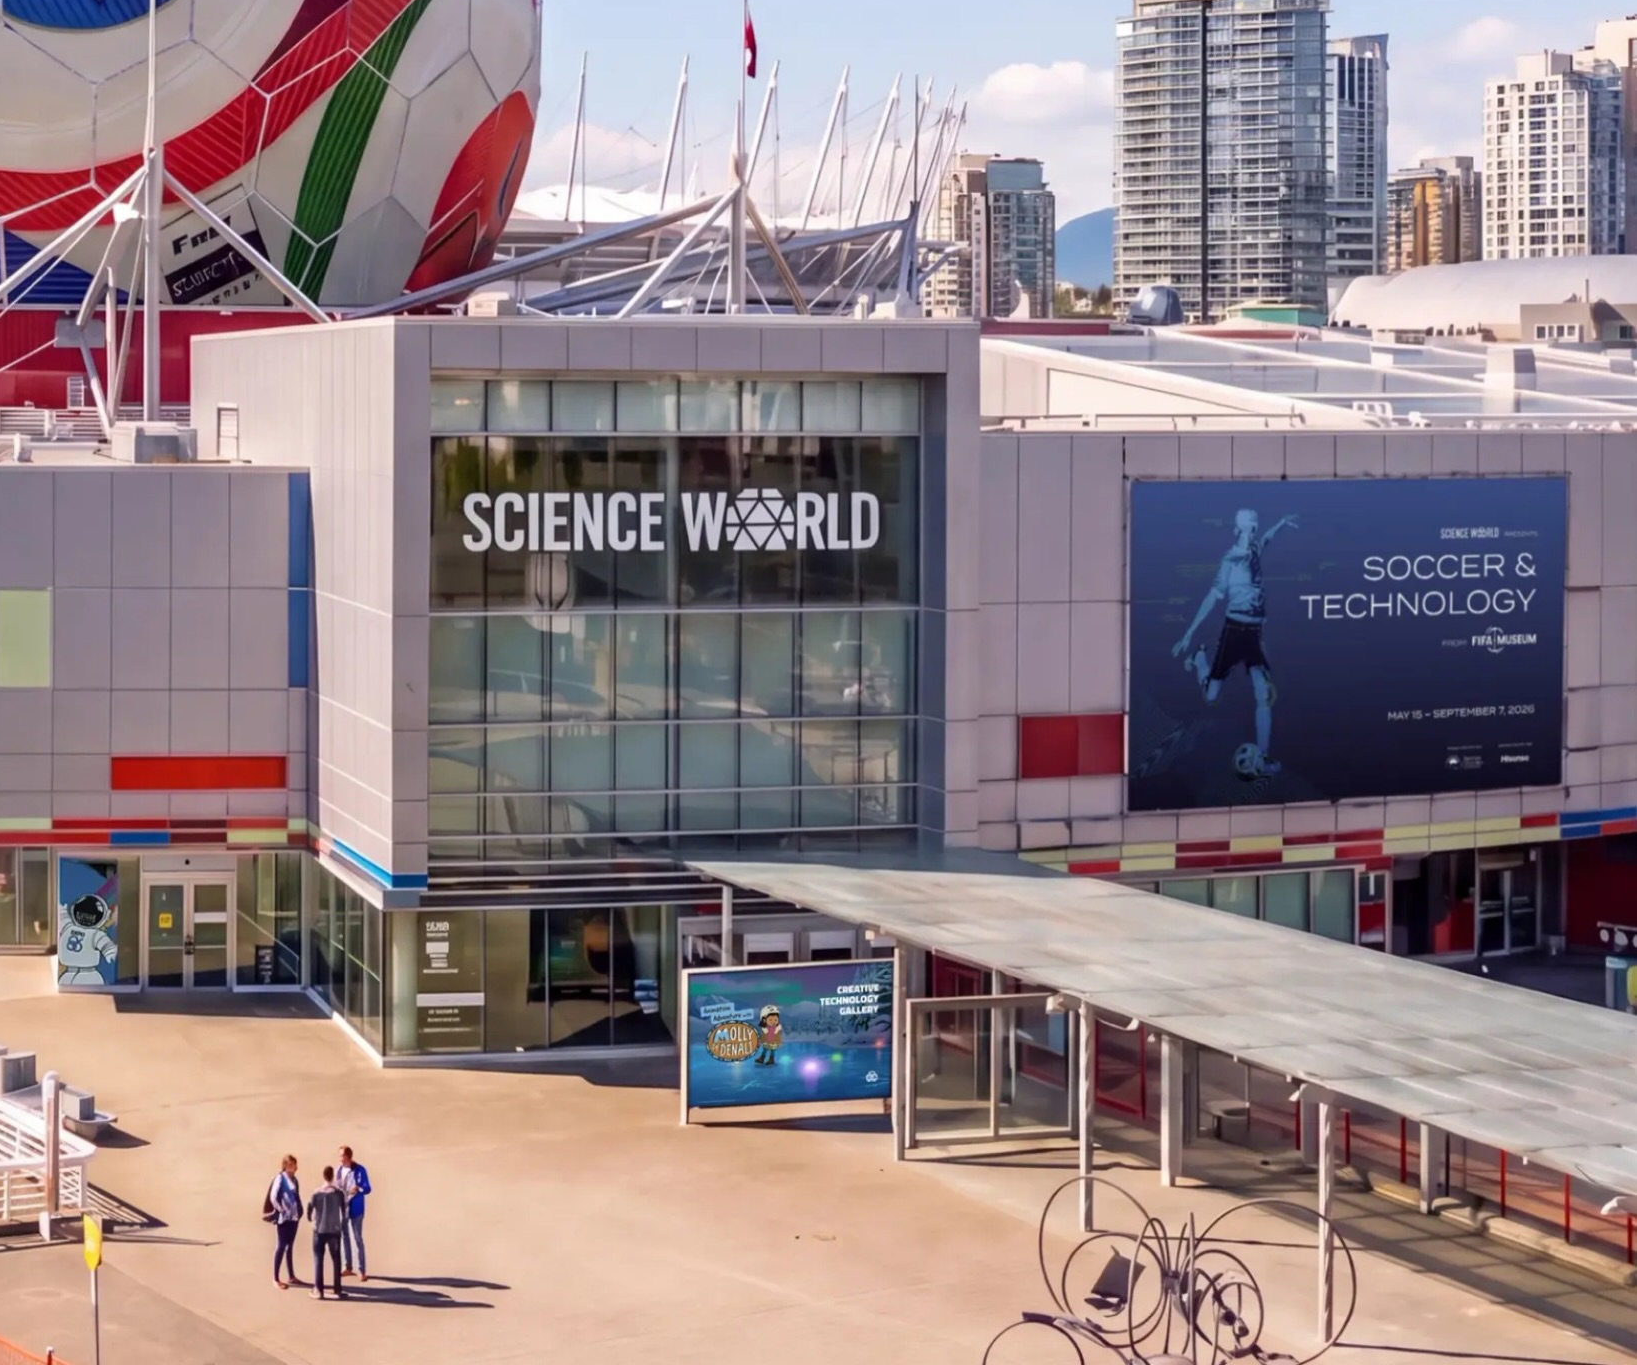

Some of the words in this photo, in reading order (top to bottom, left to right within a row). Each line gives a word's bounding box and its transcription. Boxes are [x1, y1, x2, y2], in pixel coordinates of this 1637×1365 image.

[462, 491, 665, 552] SCIENCE
[681, 488, 880, 552] WORLD
[1440, 527, 1469, 540] SCIENCE
[1363, 553, 1505, 581] SOCCER
[1515, 552, 1538, 577] &
[1299, 588, 1537, 620] TECHNOLOGY
[1471, 635, 1493, 647] FIFA
[1496, 633, 1537, 645] MUSEUM
[1387, 710, 1411, 721] MAY
[1412, 710, 1423, 720] 15
[1433, 706, 1496, 719] SEPTEMBER
[1507, 704, 1536, 715] 2026
[836, 983, 880, 995] CREATIVE
[819, 994, 879, 1007] TECHNOLOGY
[839, 1005, 879, 1016] GALLERY
[713, 1026, 754, 1043] MOLLY
[720, 1041, 753, 1057] DENALI
